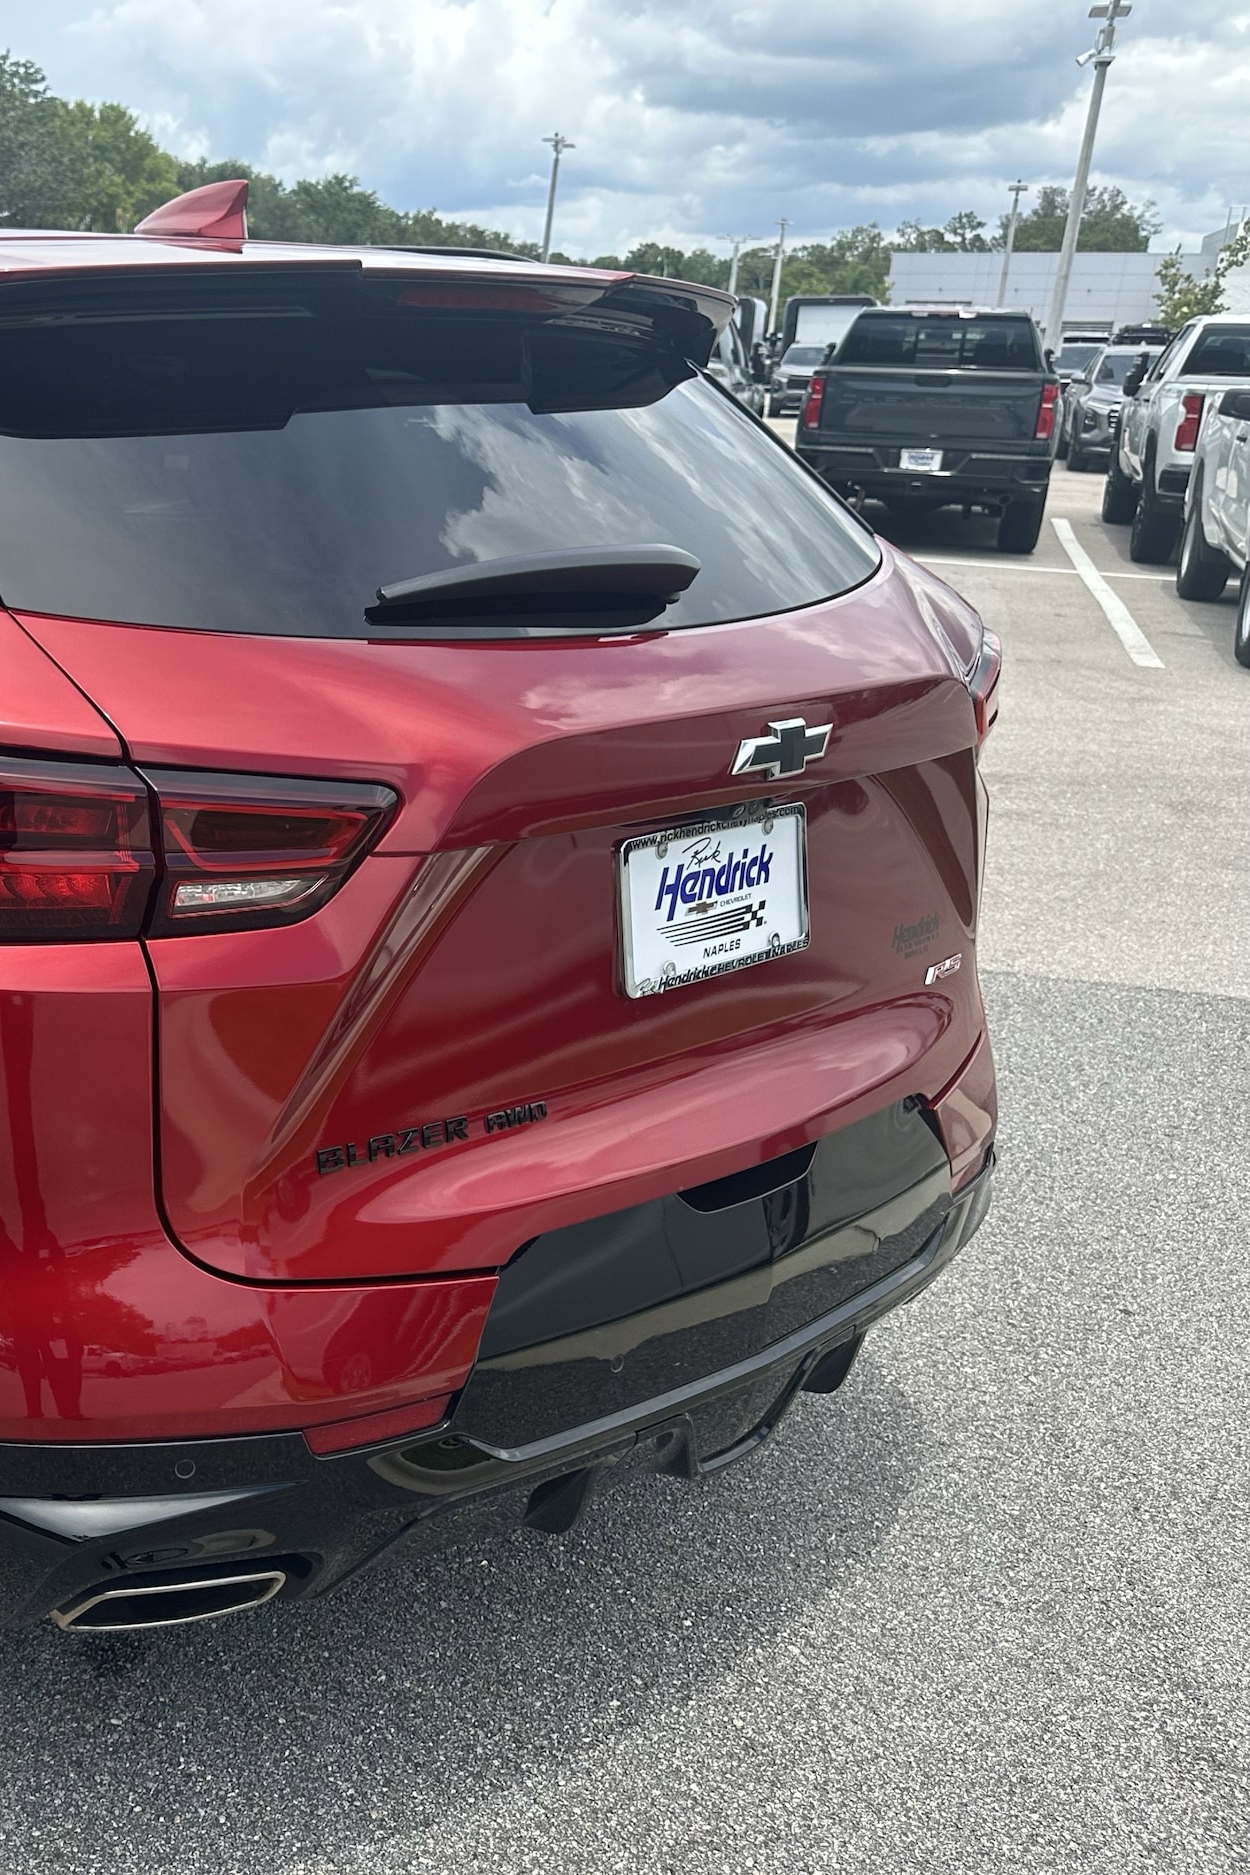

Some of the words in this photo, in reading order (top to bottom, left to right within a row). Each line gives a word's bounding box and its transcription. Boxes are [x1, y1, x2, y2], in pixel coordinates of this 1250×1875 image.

[654, 843, 773, 922] Hendrick
[719, 892, 752, 907] CHEVROLET
[658, 964, 710, 991] Hendrick
[709, 950, 770, 975] CHEVROLET
[770, 936, 809, 957] NAPLES
[703, 938, 741, 958] NAPLES
[924, 953, 962, 986] RS
[316, 1115, 470, 1175] BLAZER
[485, 1100, 548, 1134] AWD
